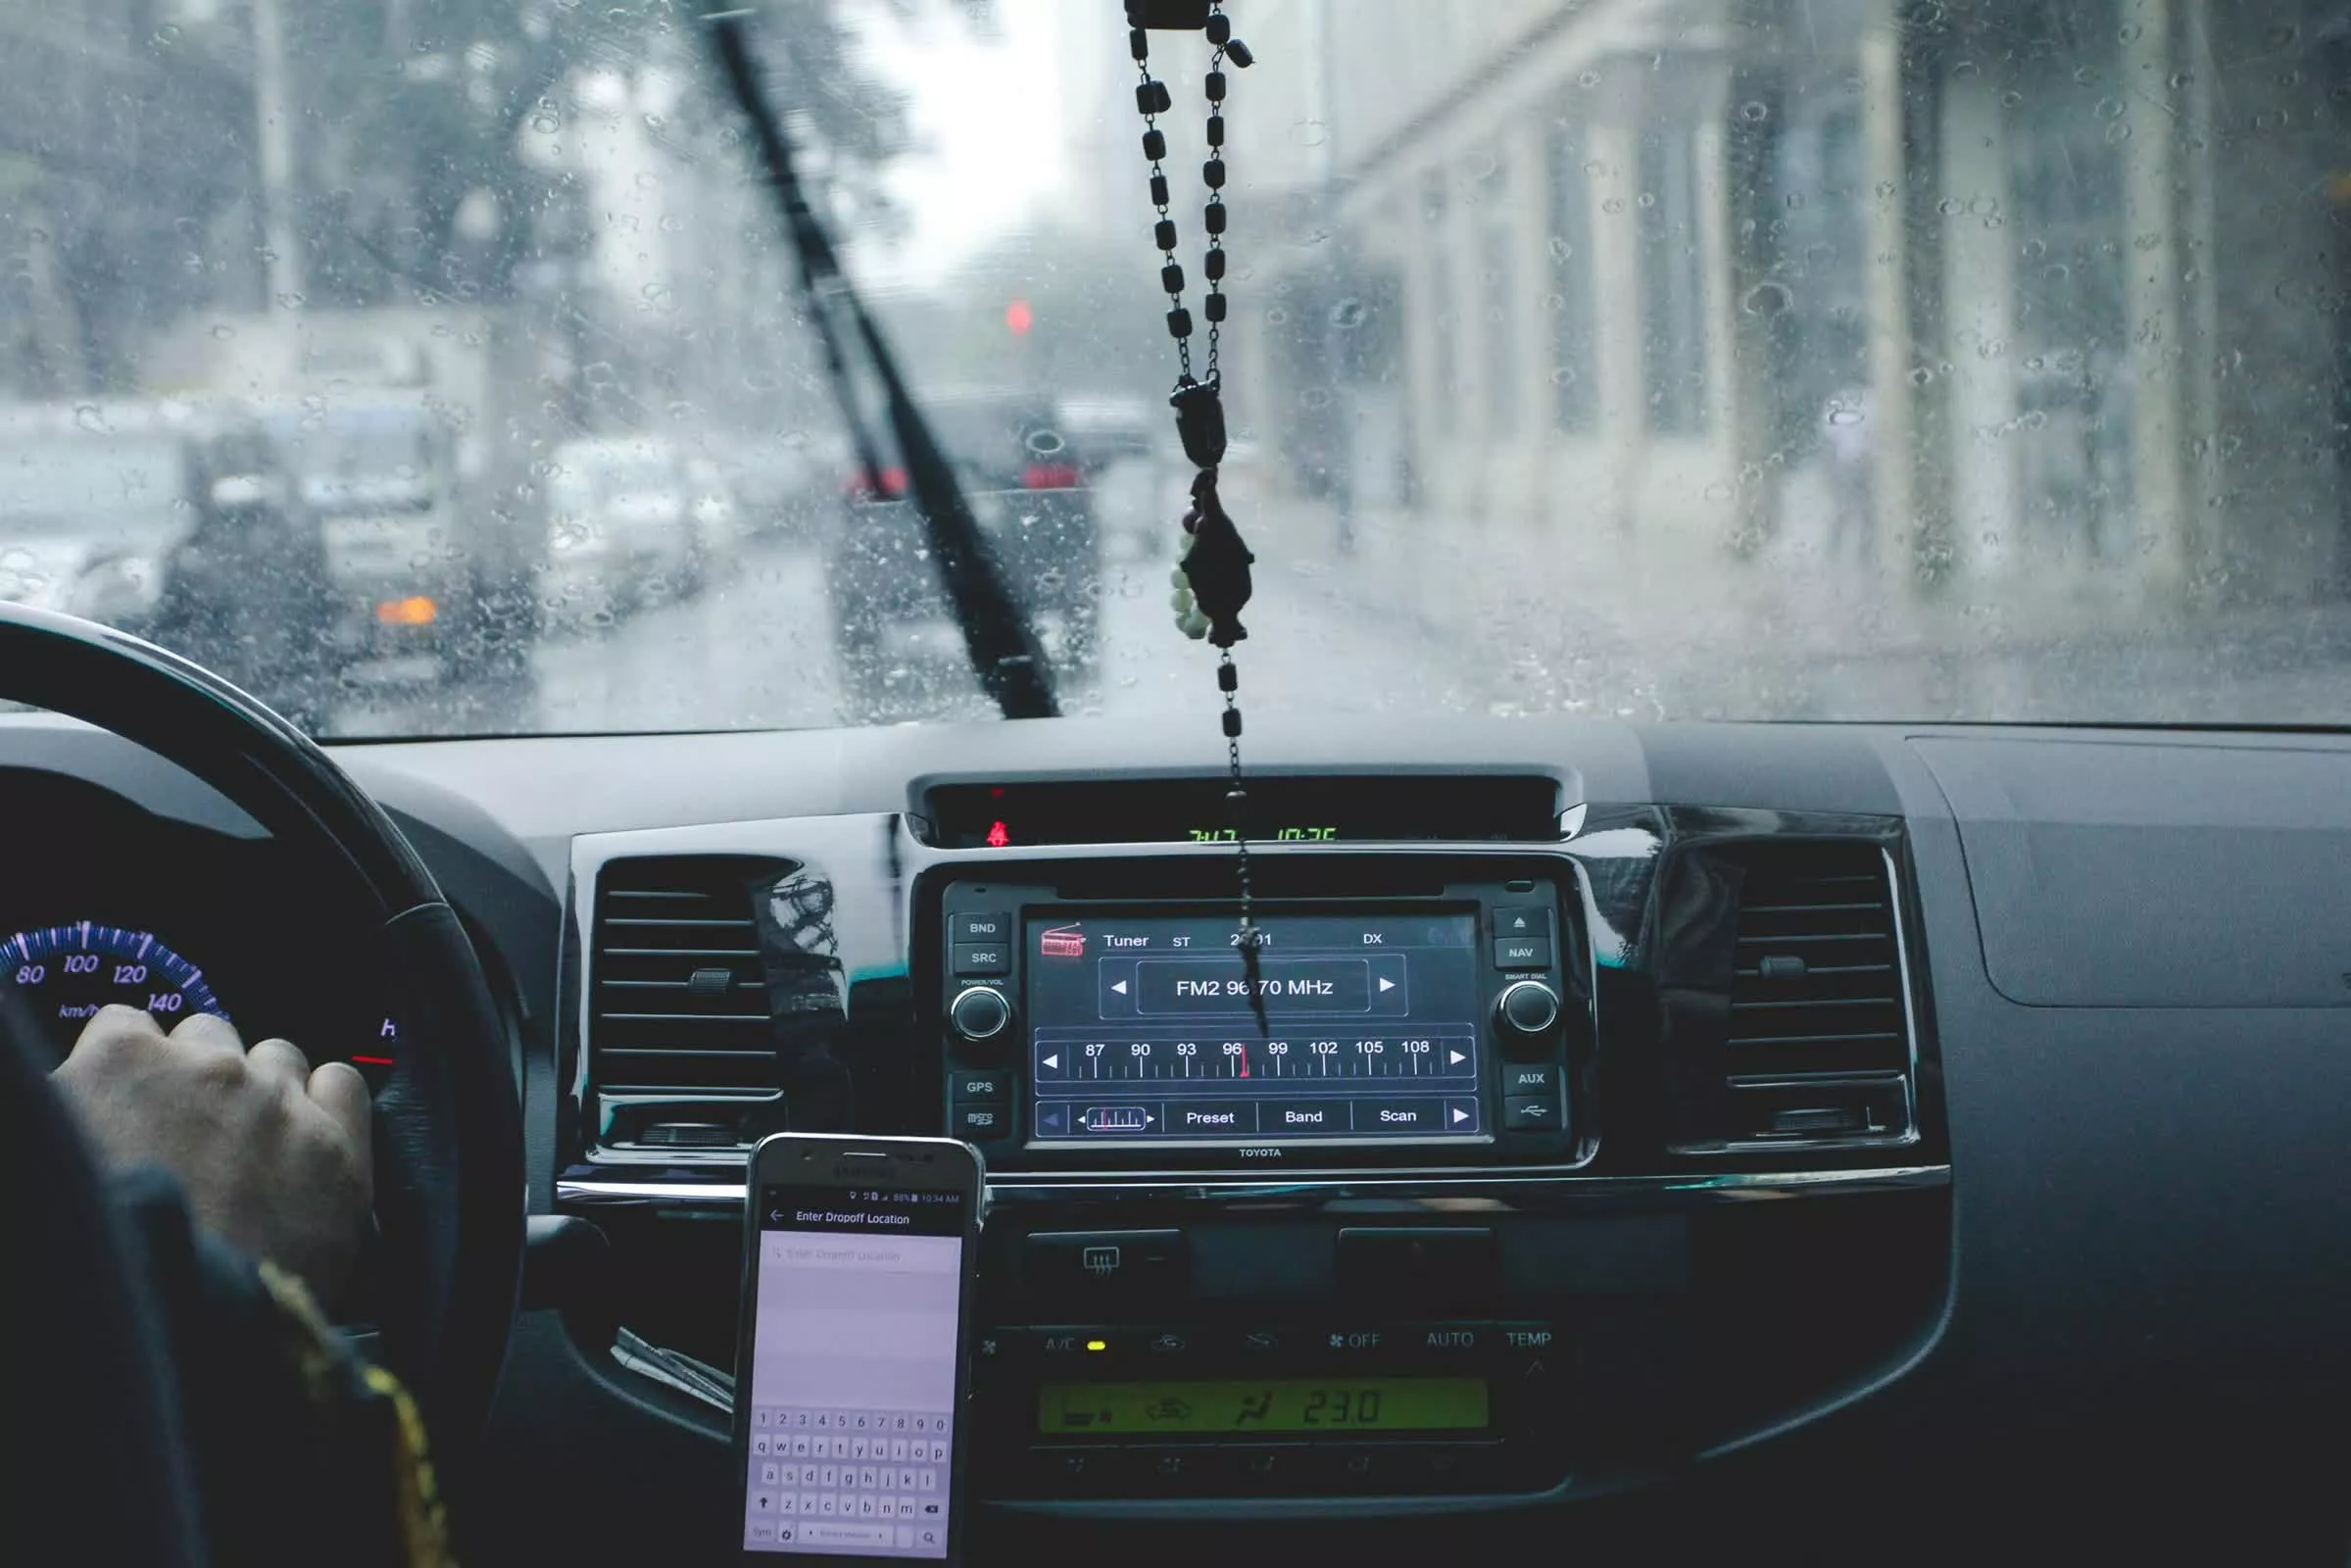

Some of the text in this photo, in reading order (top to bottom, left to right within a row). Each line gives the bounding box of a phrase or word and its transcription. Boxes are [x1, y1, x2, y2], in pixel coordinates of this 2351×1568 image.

[969, 923, 996, 933] BND
[1103, 934, 1150, 947] Tuner
[1172, 936, 1191, 947] ST
[1363, 933, 1383, 945] DX
[971, 953, 997, 963] SRC
[1508, 948, 1534, 957] NAV
[64, 955, 98, 973] 100
[16, 965, 45, 983] 80
[113, 965, 147, 983] 120
[1176, 980, 1334, 996] FM2 9670 MHz
[147, 993, 182, 1012] 140
[1085, 1041, 1430, 1056] 87 90 93 96 99 102 105 108
[1518, 1073, 1544, 1084] AUX
[966, 1082, 994, 1092] GPS
[1187, 1112, 1235, 1124] Preset
[1286, 1110, 1323, 1123] Band
[1380, 1110, 1417, 1122] Scan
[1239, 1148, 1282, 1157] TOYOTA
[946, 1195, 960, 1203] AM
[796, 1211, 910, 1225] Enter Dropoff Location
[1046, 1337, 1075, 1350] A/C
[1348, 1334, 1381, 1348] OFF
[1427, 1332, 1474, 1347] AUTO
[1505, 1332, 1552, 1347] TEMP
[1304, 1390, 1381, 1424] 23.0
[780, 1414, 787, 1425] 2
[799, 1414, 807, 1425] 3
[818, 1415, 826, 1426] 4
[839, 1416, 846, 1427] 5
[857, 1417, 865, 1428] 6
[878, 1417, 886, 1428] 7
[897, 1418, 905, 1429] 8
[916, 1419, 924, 1430] 9
[936, 1420, 944, 1431] 0
[759, 1441, 765, 1452] q
[798, 1444, 806, 1452] e
[857, 1446, 863, 1456] y
[876, 1446, 883, 1455] u
[935, 1448, 943, 1459] p
[766, 1471, 774, 1480] a
[786, 1472, 793, 1481] s
[806, 1470, 813, 1481] d
[845, 1474, 853, 1485] g
[864, 1472, 872, 1483] h
[905, 1474, 911, 1486] k
[785, 1500, 792, 1509] z
[805, 1501, 811, 1510] x
[824, 1502, 831, 1511] c
[863, 1501, 871, 1512] b
[884, 1504, 891, 1513] n
